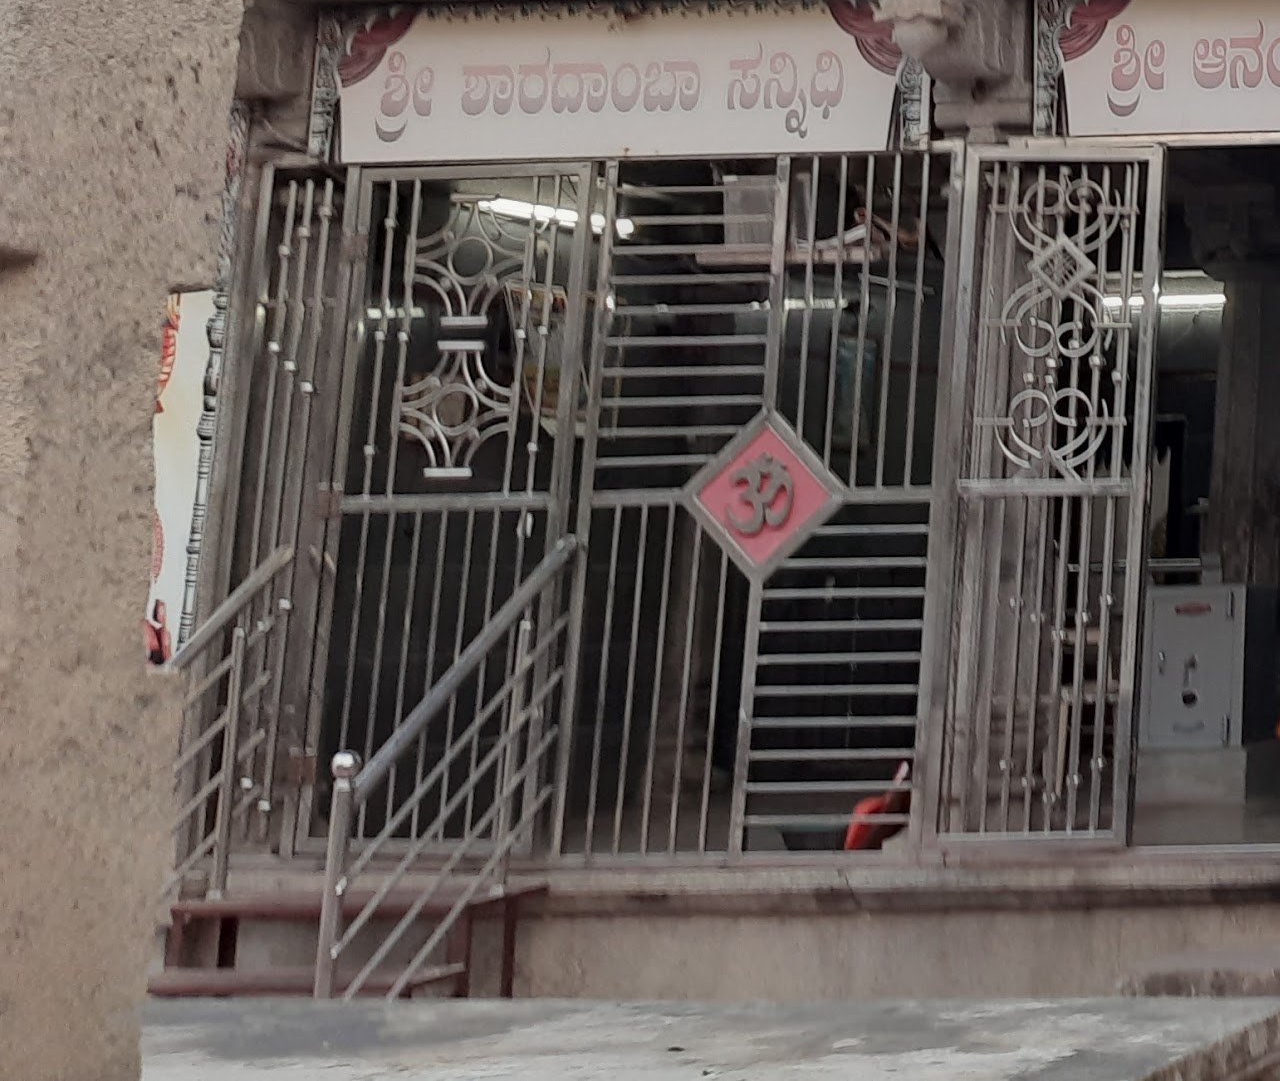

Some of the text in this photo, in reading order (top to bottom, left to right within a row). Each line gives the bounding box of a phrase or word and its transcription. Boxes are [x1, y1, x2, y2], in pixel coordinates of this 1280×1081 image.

[374, 42, 846, 143] ಶ್ರೀ ಶಾರದಾಂಬಾ ಸನ್ನಿಧಿ
[1107, 21, 1166, 117] ಶ್ರೀ
